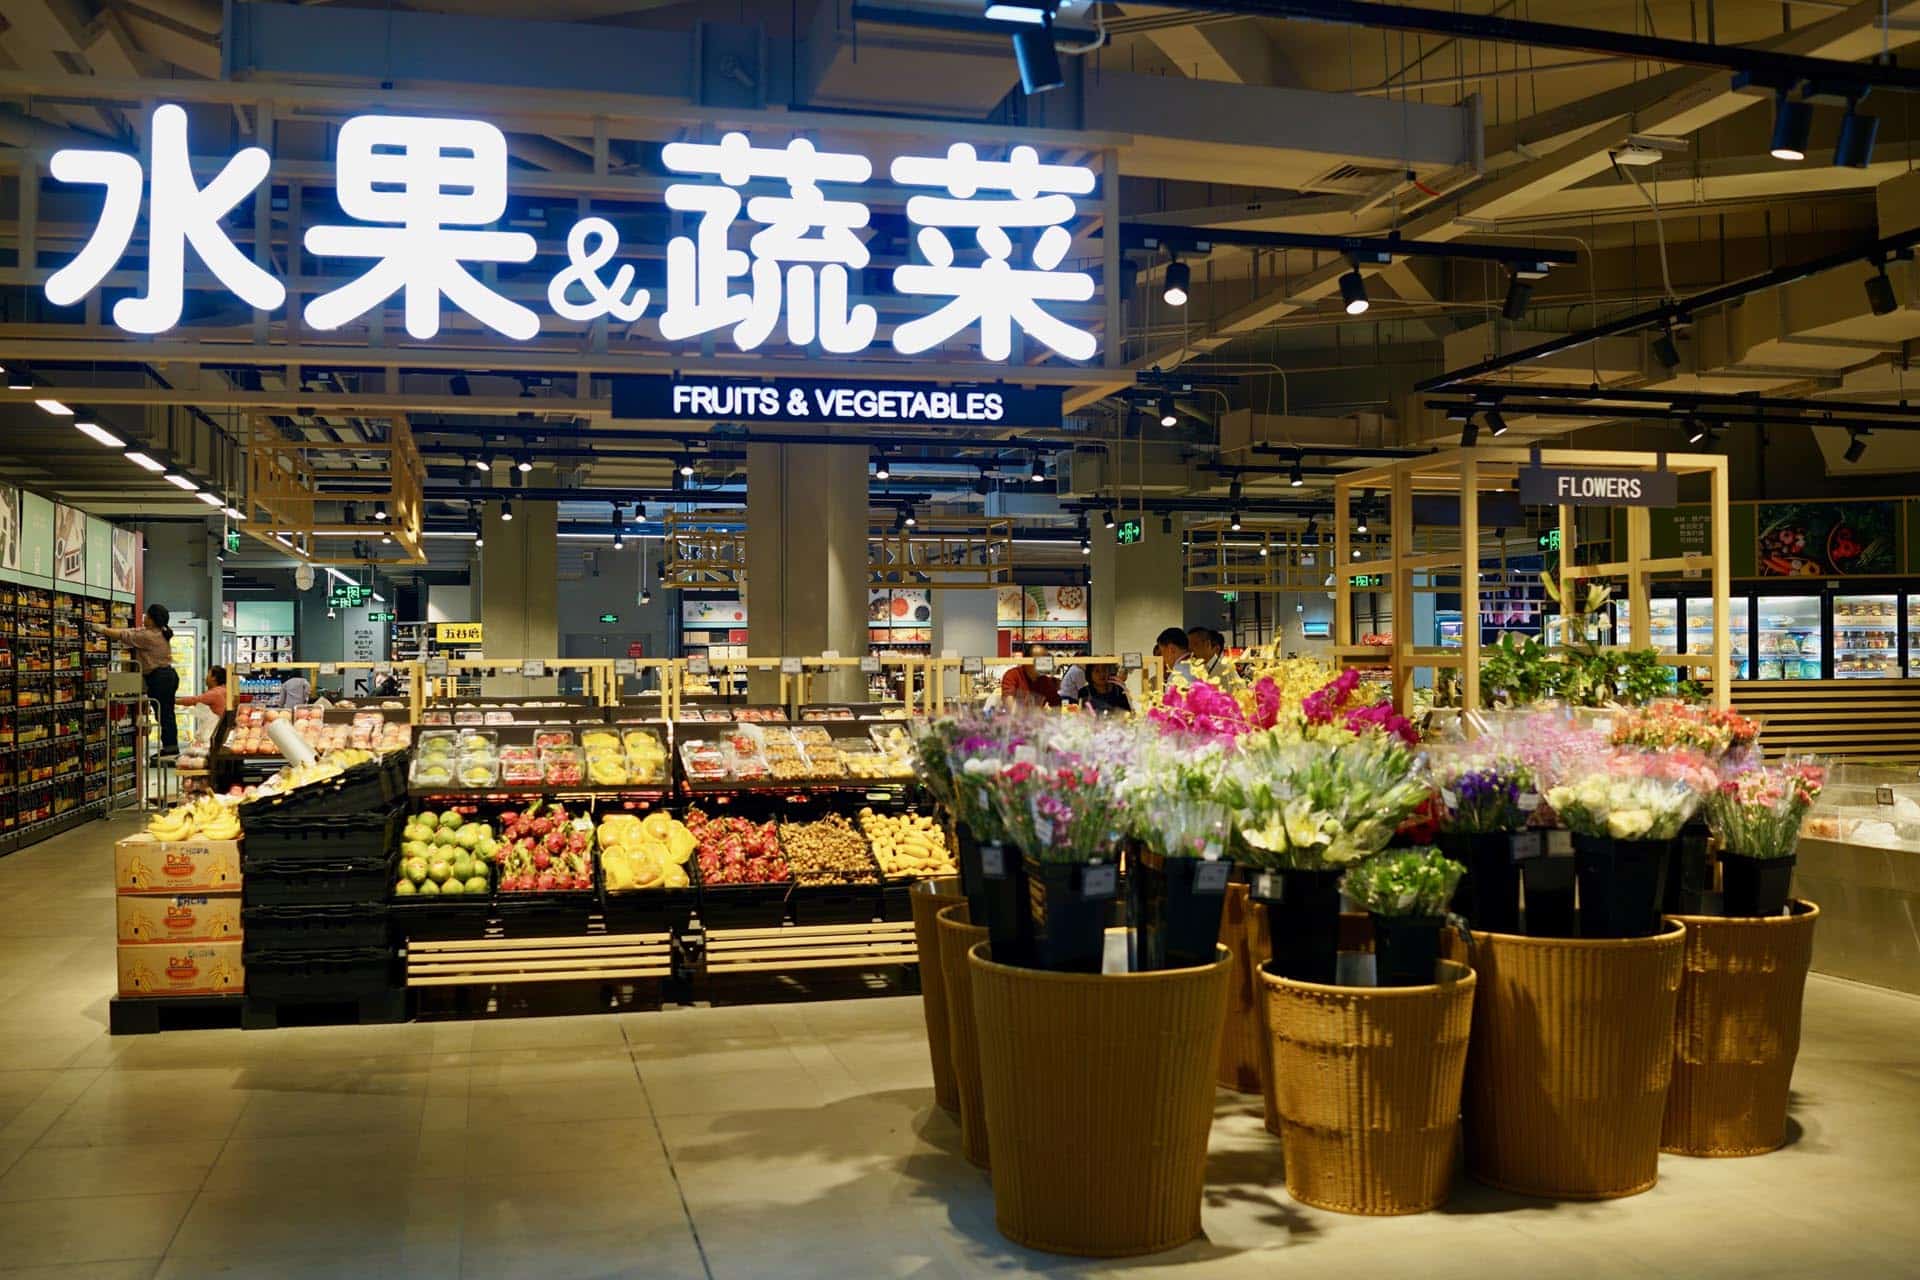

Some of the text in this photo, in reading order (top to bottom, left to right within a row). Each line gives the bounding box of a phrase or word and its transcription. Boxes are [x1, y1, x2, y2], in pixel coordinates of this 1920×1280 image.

[673, 386, 1004, 422] FRUITS & VEGETABLES
[1557, 475, 1642, 500] FLOWERS
